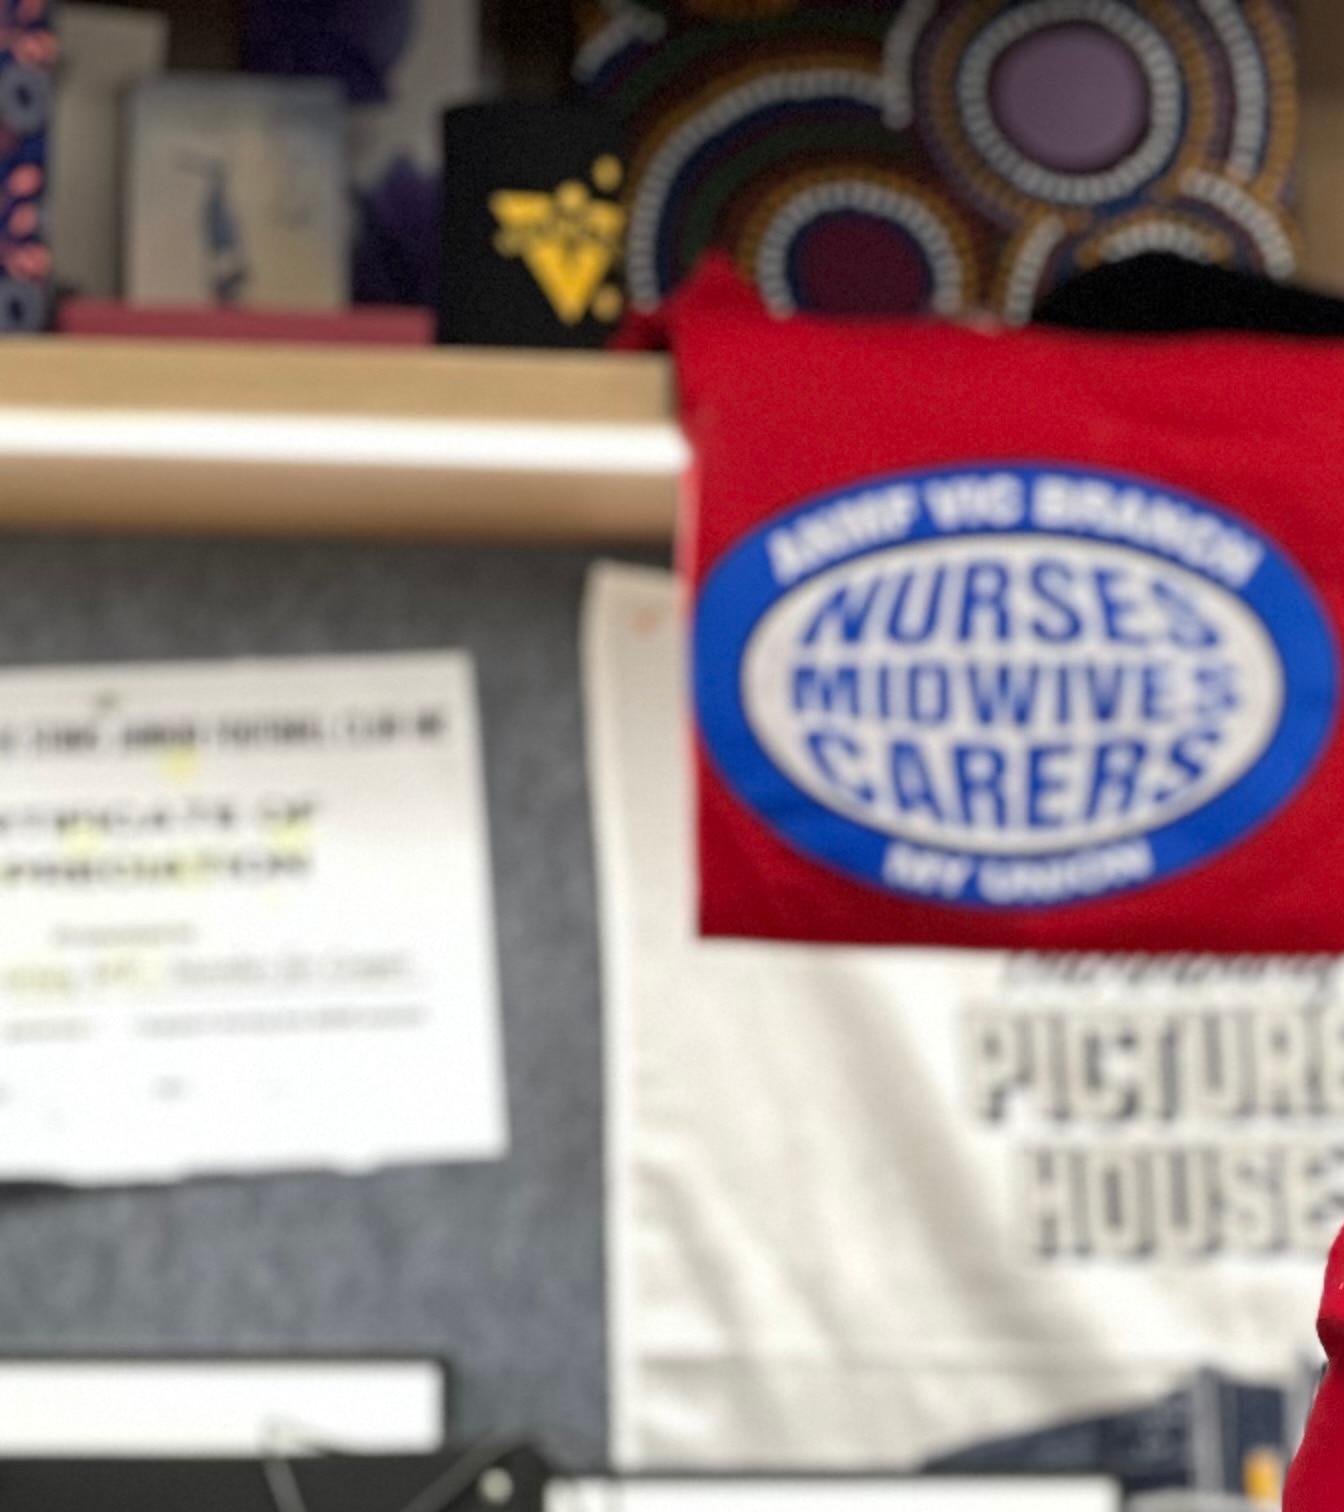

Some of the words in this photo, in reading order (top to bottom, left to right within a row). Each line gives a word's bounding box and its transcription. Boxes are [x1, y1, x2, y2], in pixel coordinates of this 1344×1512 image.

[925, 472, 1025, 532] VIC
[1031, 473, 1267, 590] BRANCH
[801, 557, 1221, 650] NURSES
[792, 662, 1238, 727] MIDWIVES
[806, 729, 1222, 829] CARERS
